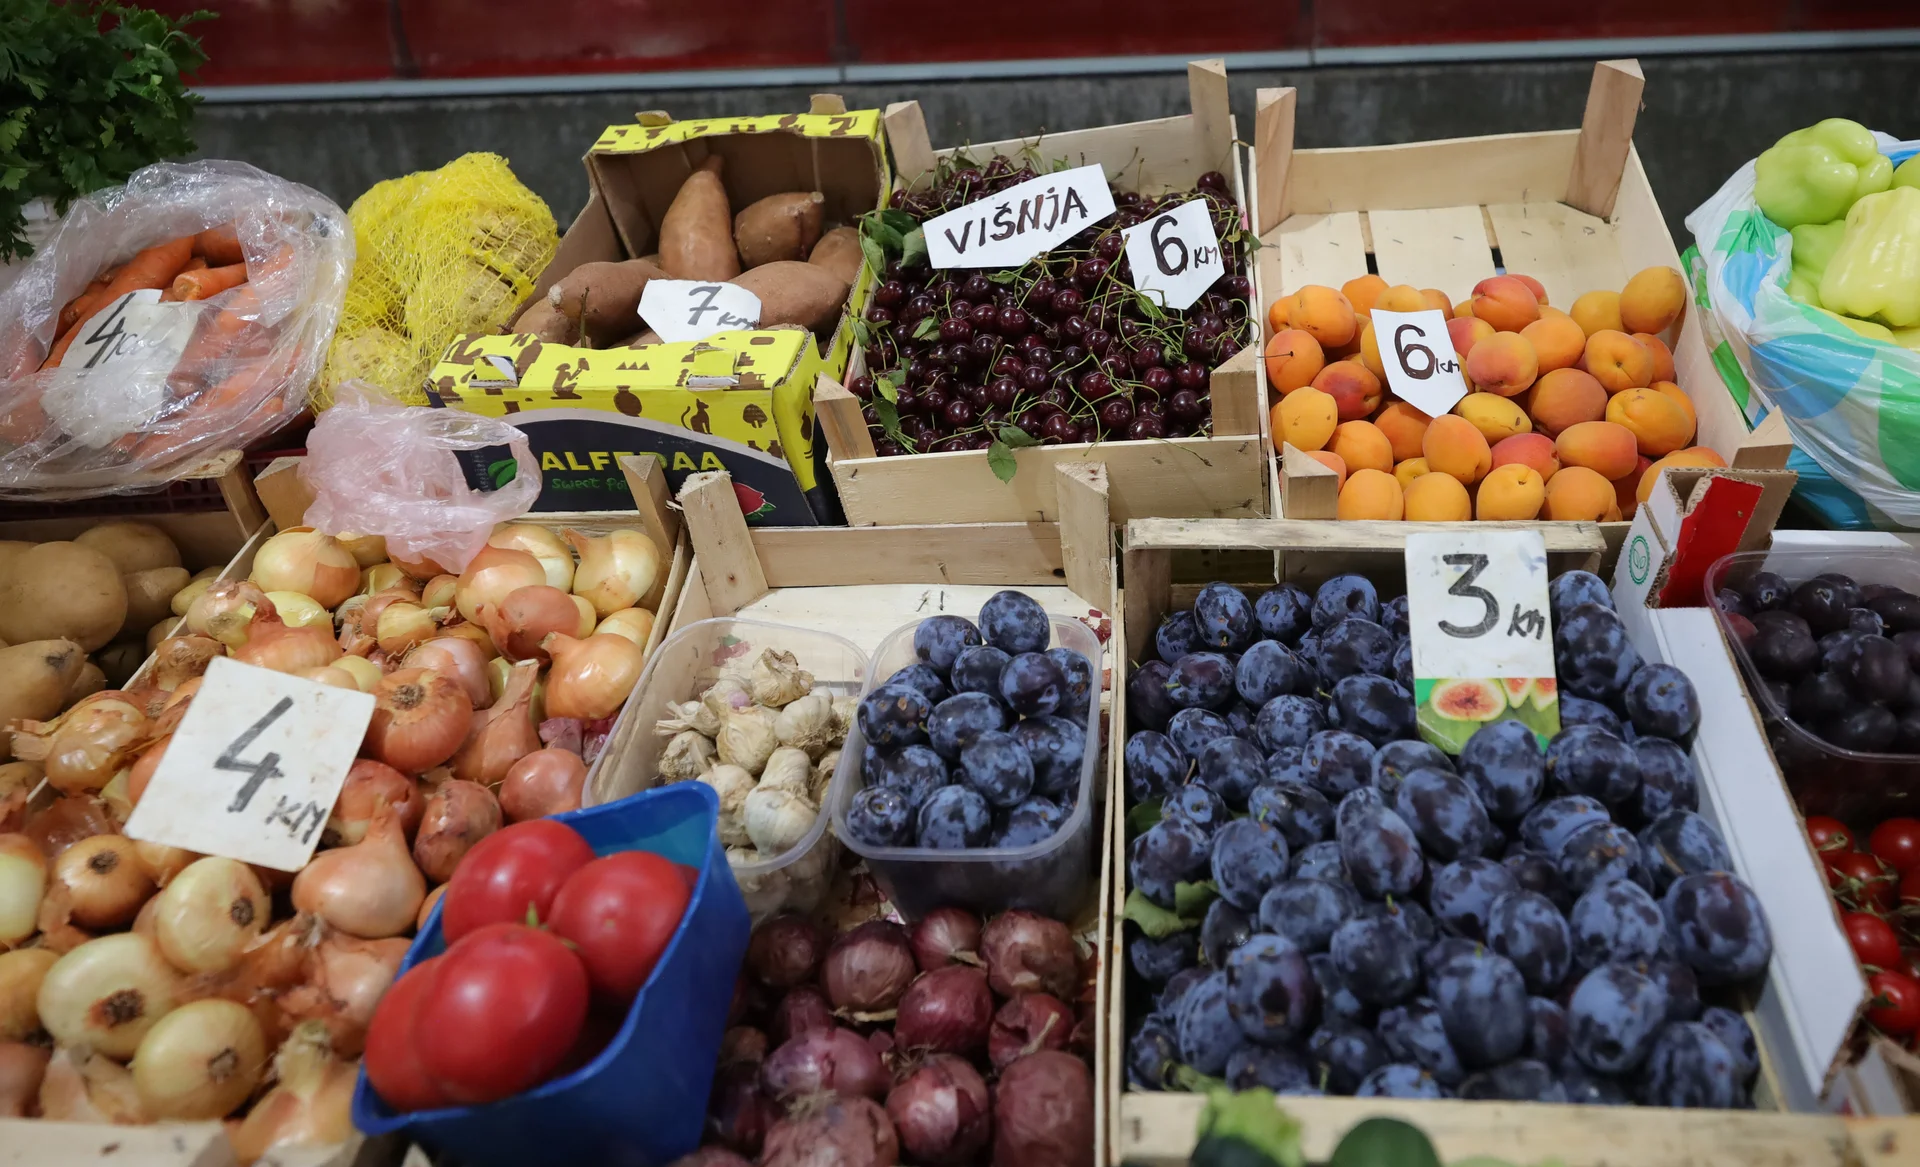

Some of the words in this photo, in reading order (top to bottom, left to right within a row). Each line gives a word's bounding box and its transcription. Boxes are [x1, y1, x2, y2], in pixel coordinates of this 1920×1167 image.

[1150, 215, 1188, 276] 6
[77, 292, 136, 378] 4
[687, 286, 722, 326] 7
[1394, 324, 1436, 380] 6
[1438, 553, 1500, 639] 3
[214, 696, 294, 813] 4
